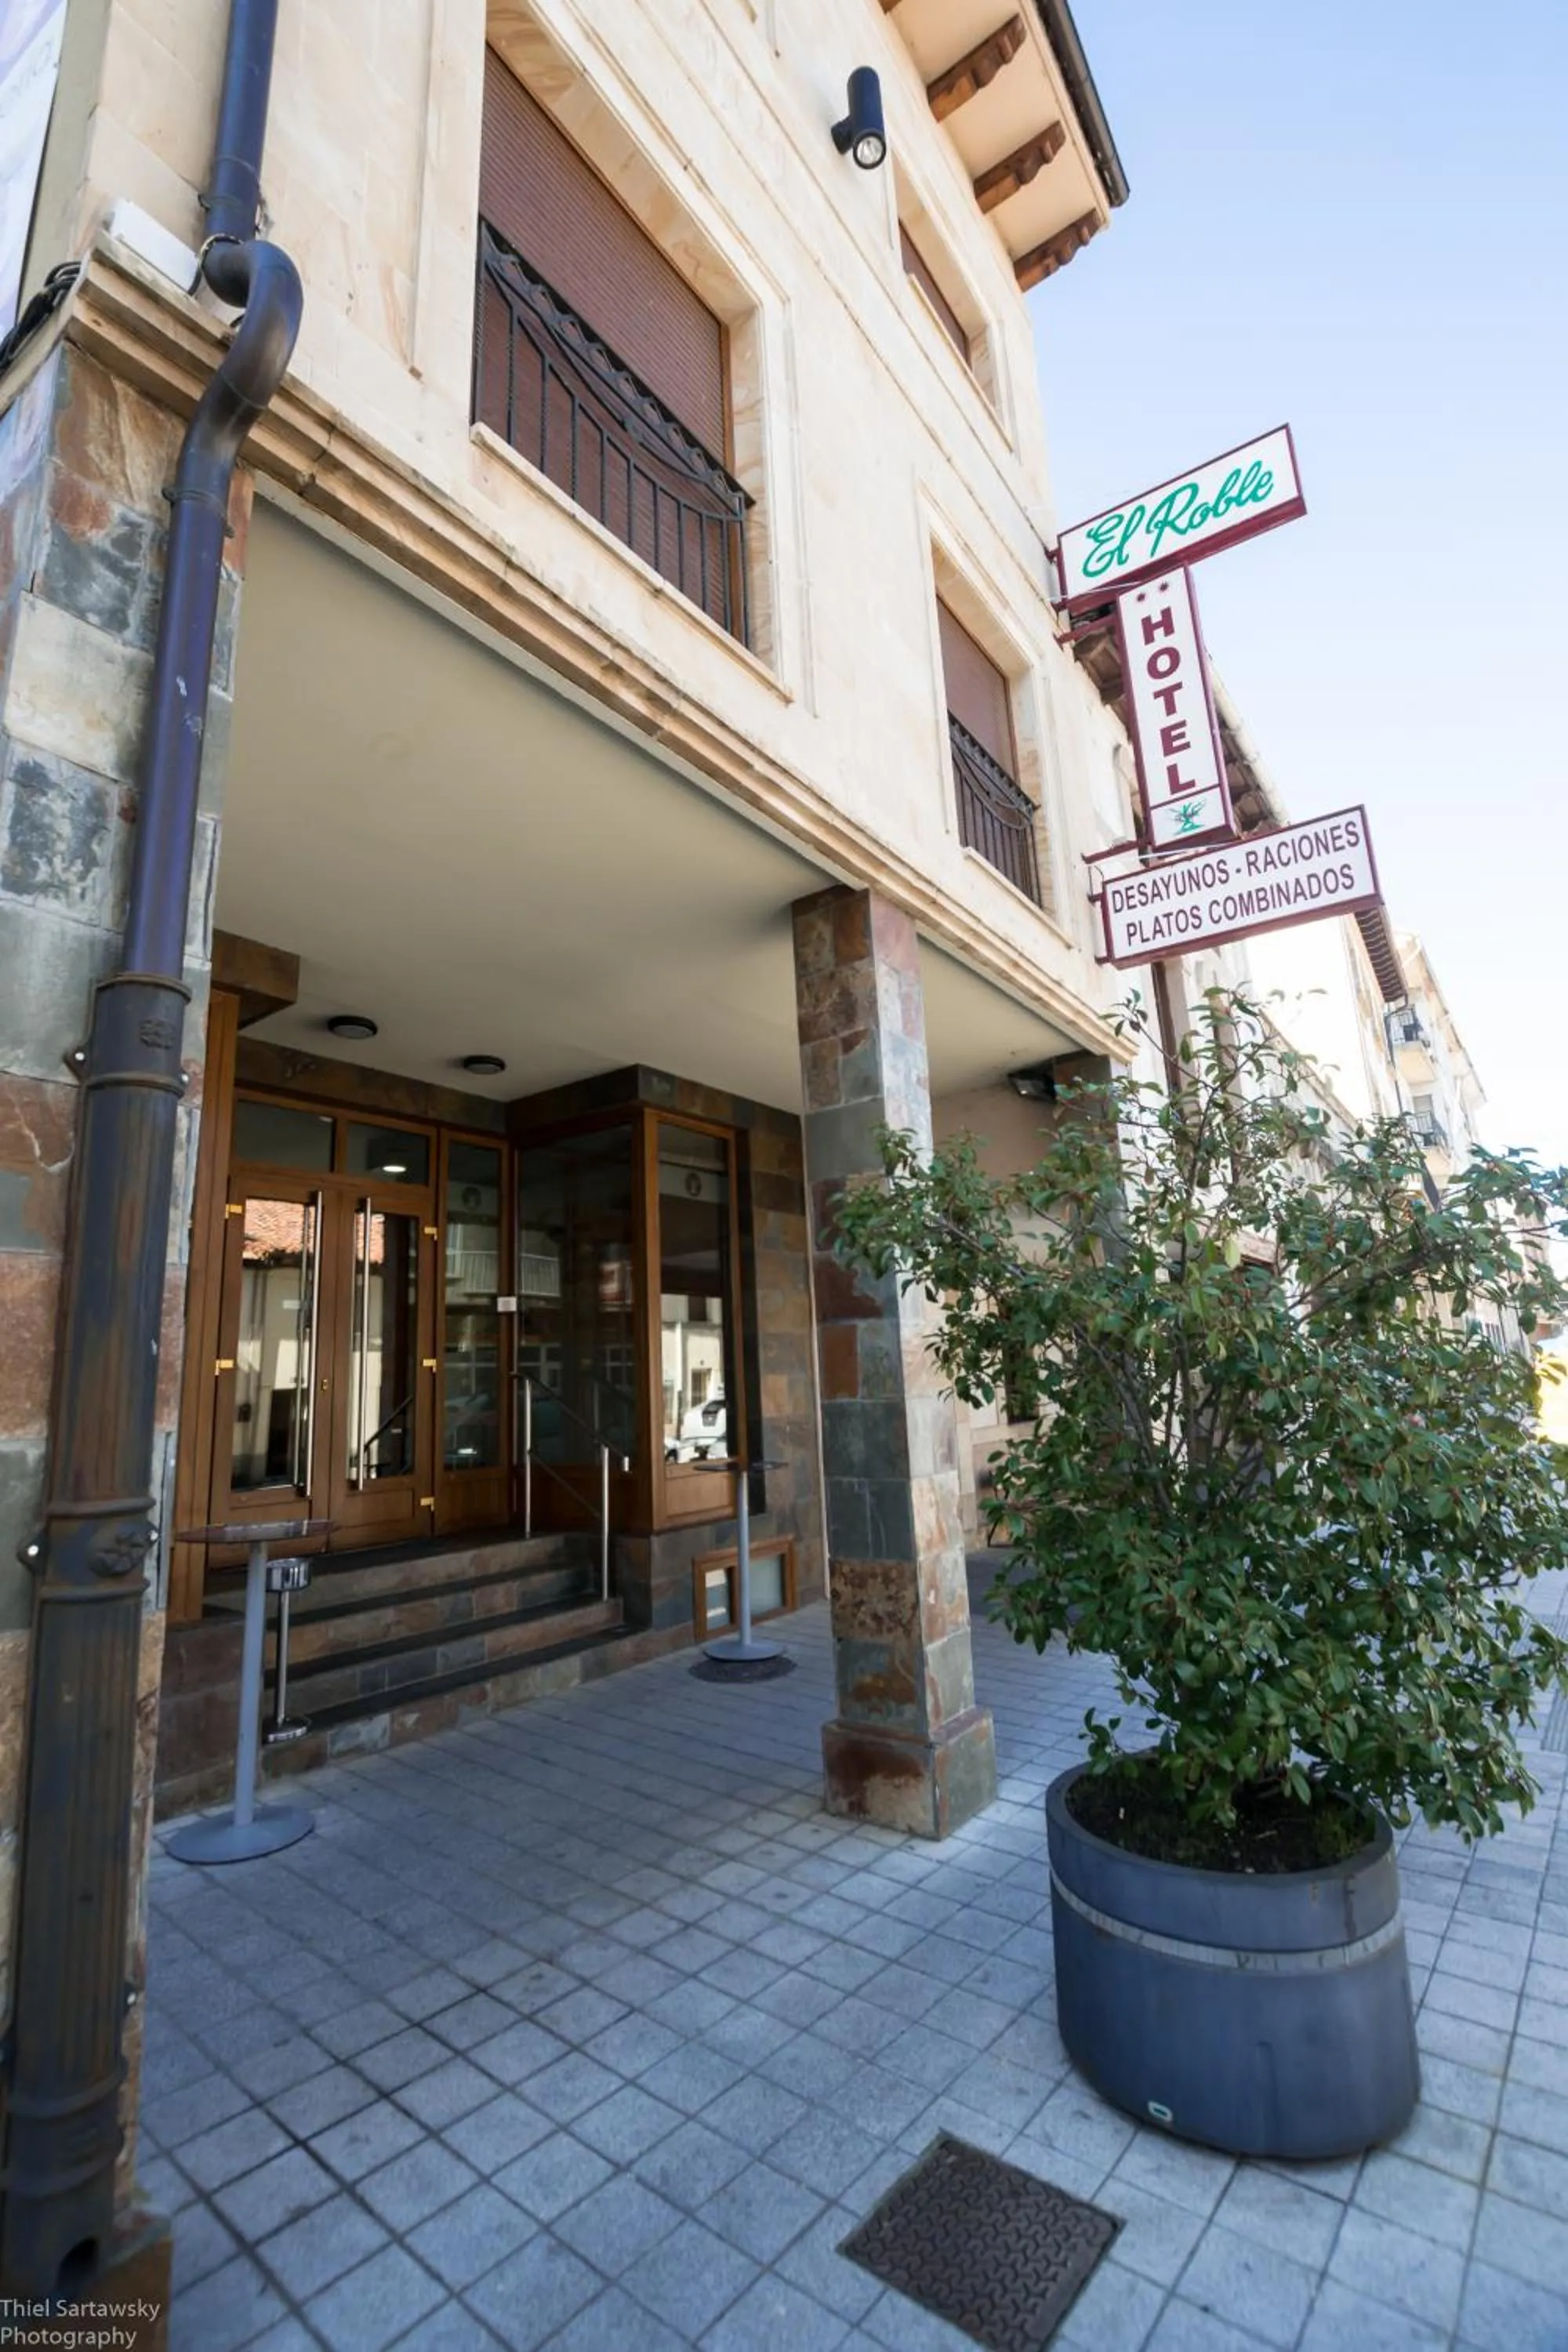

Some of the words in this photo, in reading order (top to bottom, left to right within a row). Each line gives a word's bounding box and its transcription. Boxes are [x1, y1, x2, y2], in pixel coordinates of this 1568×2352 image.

[1082, 504, 1145, 577] El
[1145, 460, 1273, 557] Roble
[1141, 606, 1196, 795] HOTEL
[1112, 859, 1229, 914] DESAYUNOS
[1245, 821, 1360, 877] RACIONES
[1127, 906, 1203, 946] PLATOS
[1208, 863, 1355, 924] COMBINADOS
